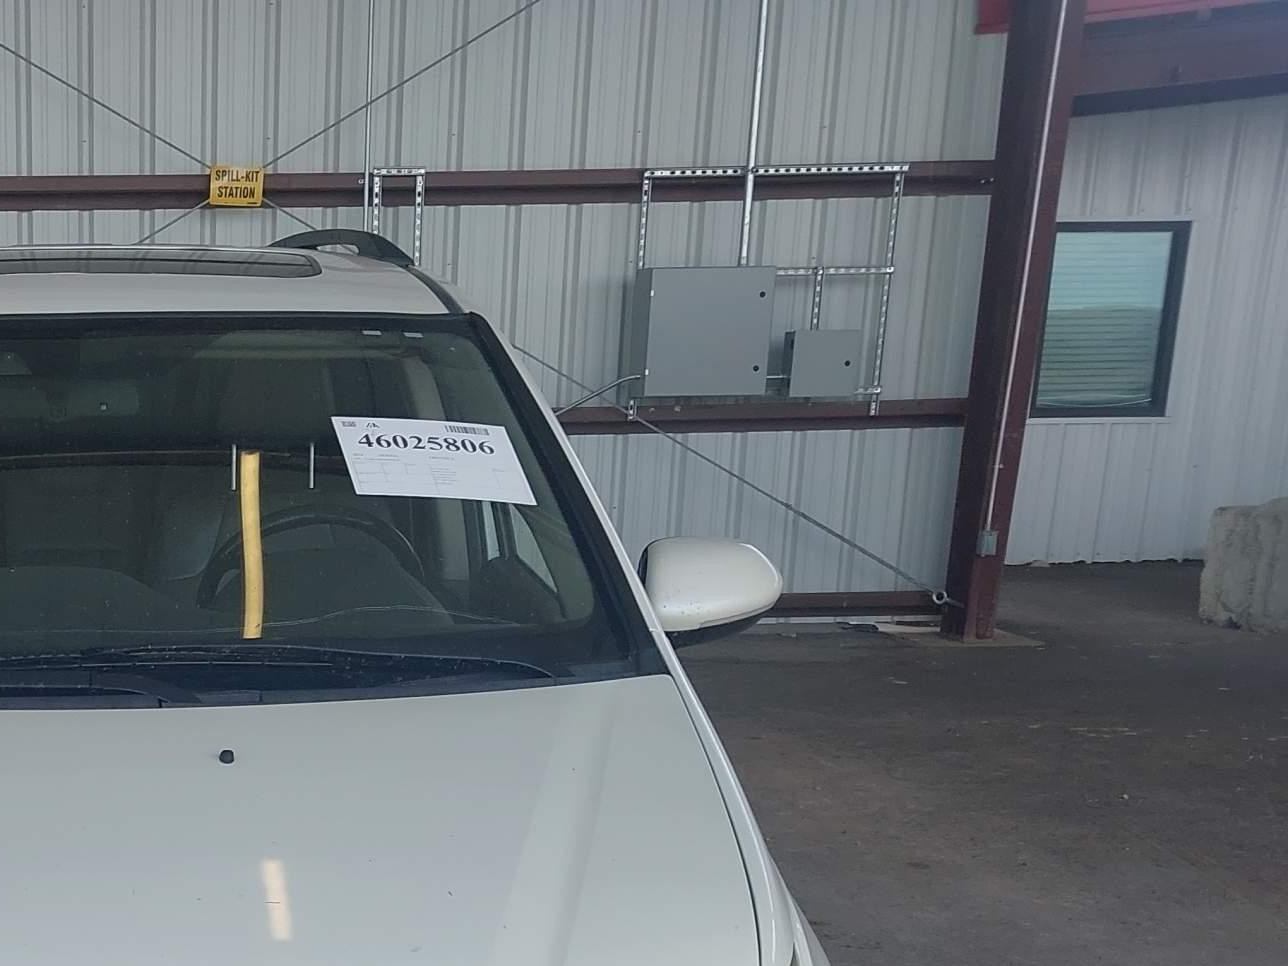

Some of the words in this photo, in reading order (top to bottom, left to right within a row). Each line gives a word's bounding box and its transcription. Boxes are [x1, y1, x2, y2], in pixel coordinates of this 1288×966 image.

[215, 169, 260, 182] SPILL-KIT
[217, 185, 256, 199] STATION
[358, 433, 495, 455] 46025806
